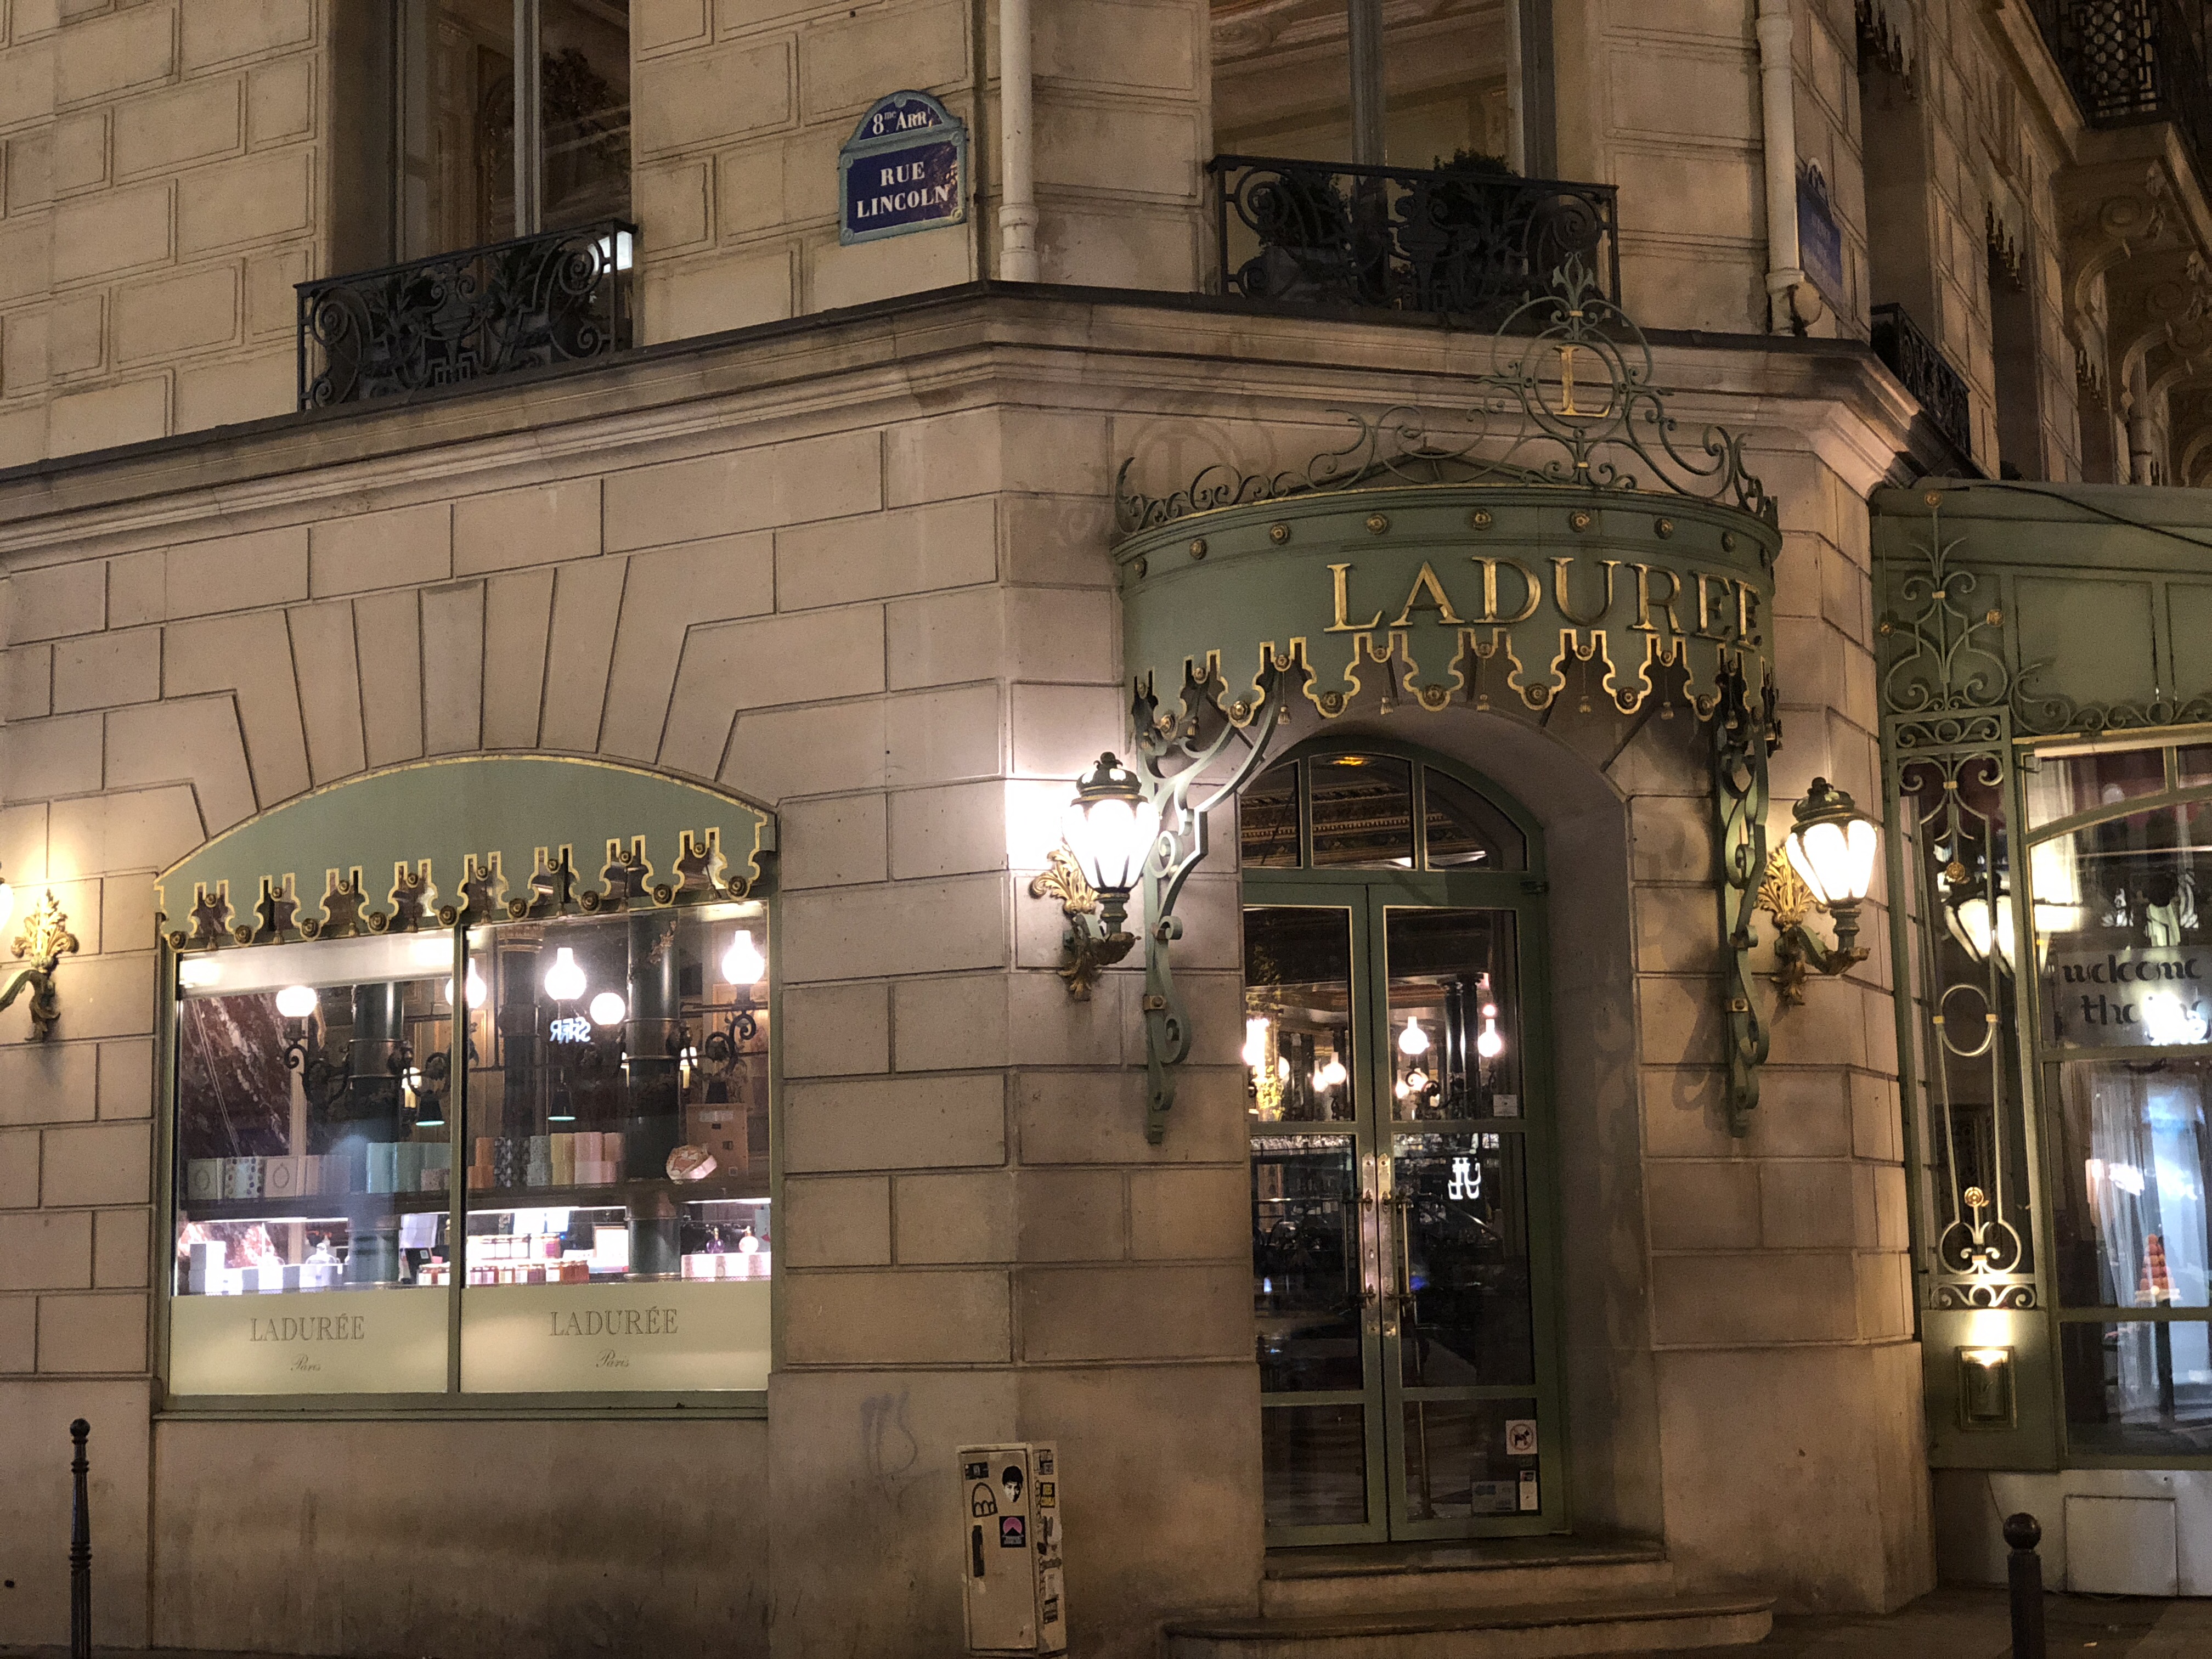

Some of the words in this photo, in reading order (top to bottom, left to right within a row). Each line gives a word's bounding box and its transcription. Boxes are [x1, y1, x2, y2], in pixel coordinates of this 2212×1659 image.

[880, 161, 925, 187] RUE
[856, 184, 949, 218] LINCOLN
[250, 1313, 365, 1341] LADURÉE
[549, 1306, 678, 1336] LADURÉE
[290, 1354, 321, 1372] Paris
[596, 1350, 629, 1368] Paris
